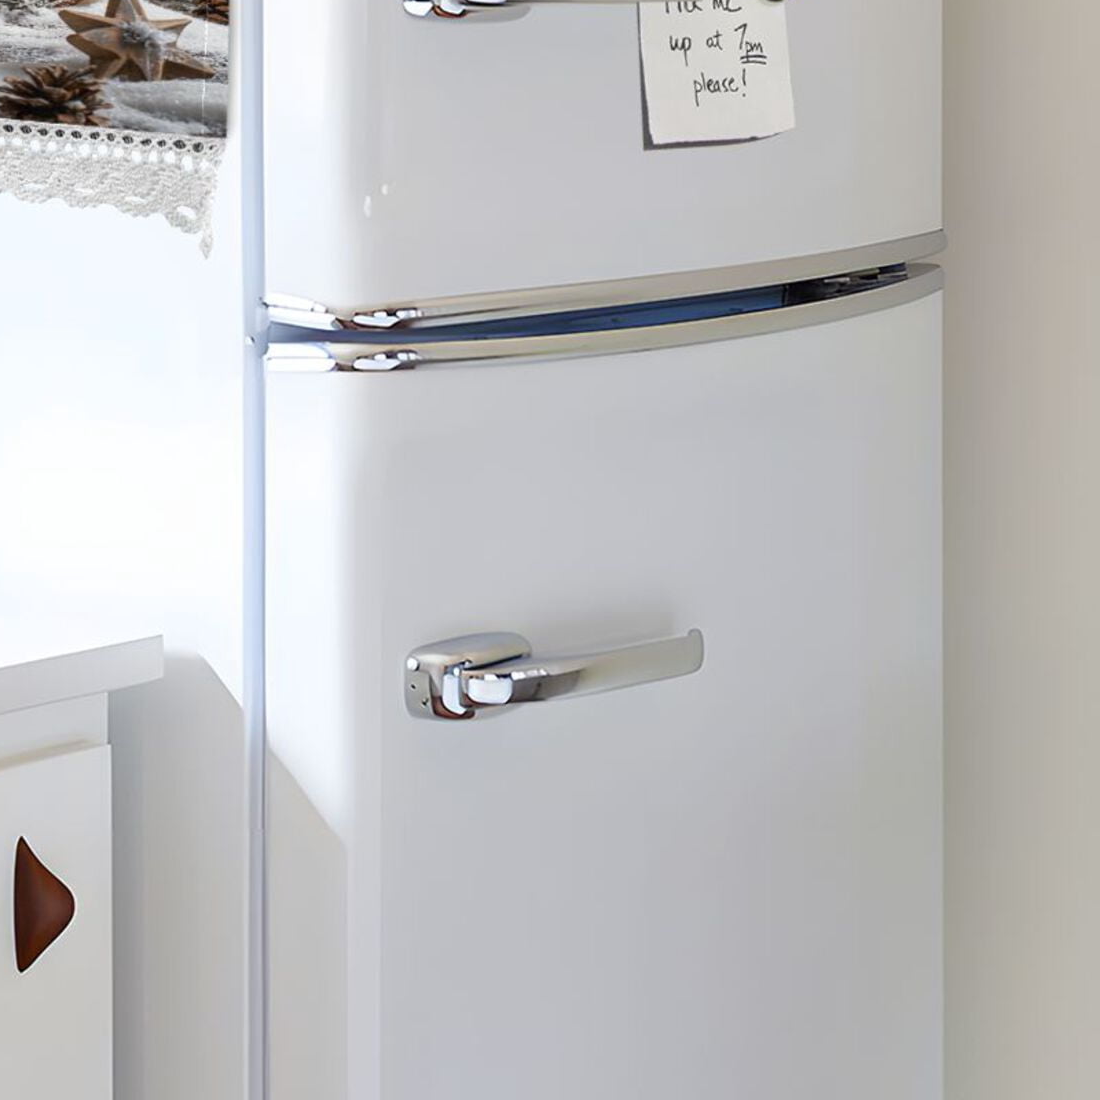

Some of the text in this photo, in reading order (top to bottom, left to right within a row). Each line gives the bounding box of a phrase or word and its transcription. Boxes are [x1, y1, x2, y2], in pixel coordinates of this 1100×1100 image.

[669, 35, 692, 66] up
[706, 30, 723, 51] at
[693, 68, 747, 107] please!
